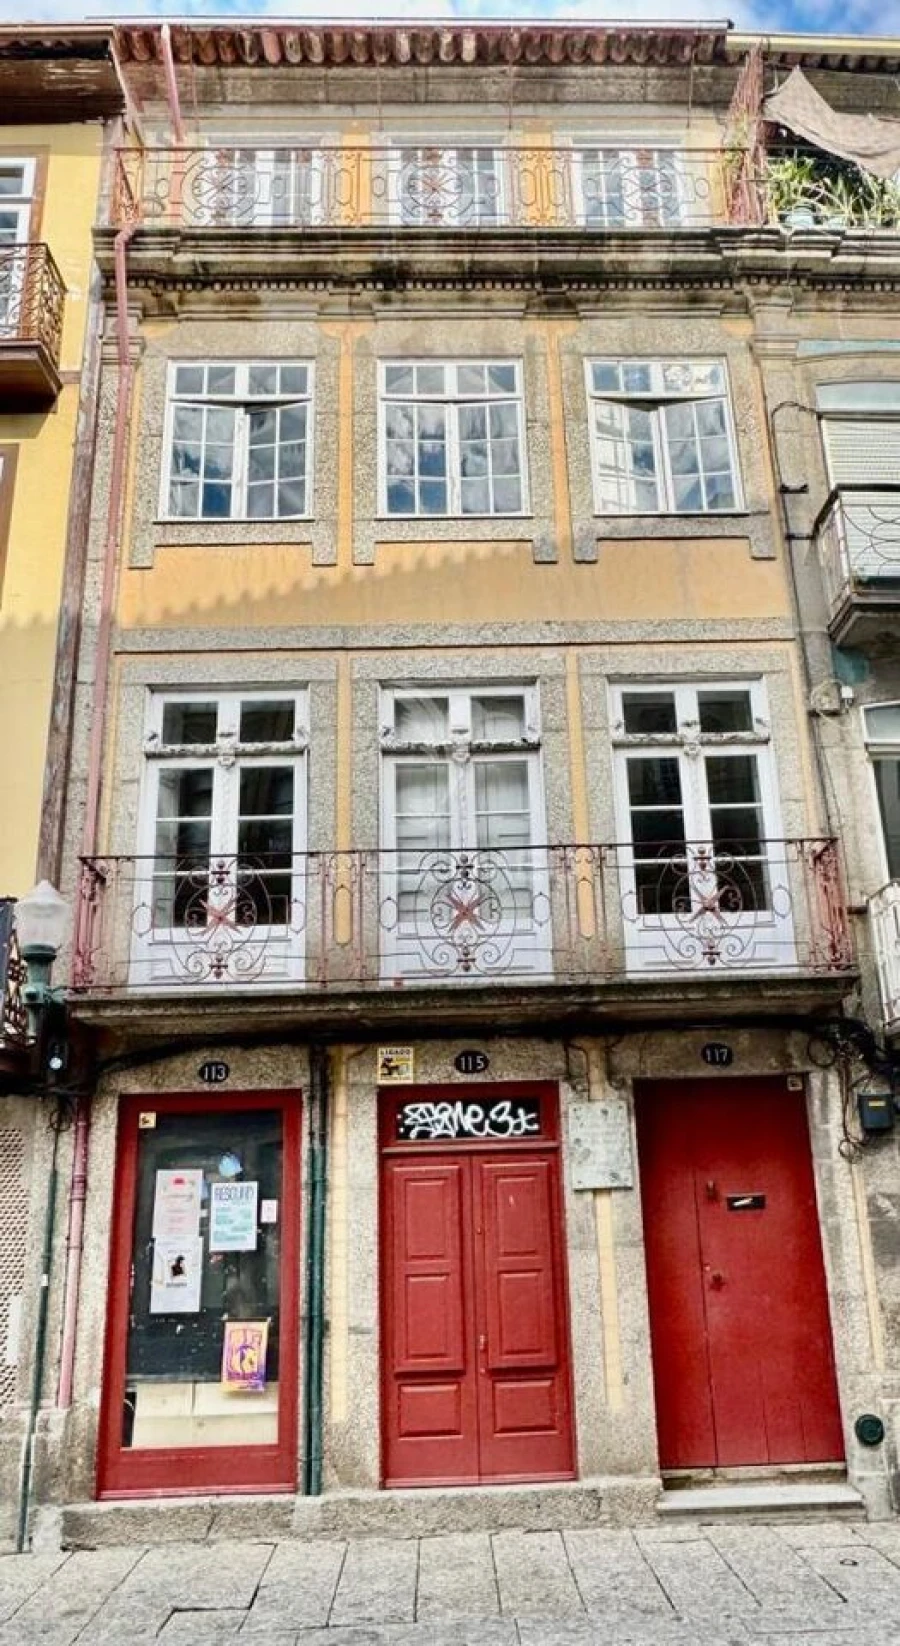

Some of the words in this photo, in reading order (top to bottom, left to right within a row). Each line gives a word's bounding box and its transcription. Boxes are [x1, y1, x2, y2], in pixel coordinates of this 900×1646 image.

[706, 1048, 728, 1062] 117
[461, 1055, 484, 1071] 115
[204, 1065, 226, 1080] 113
